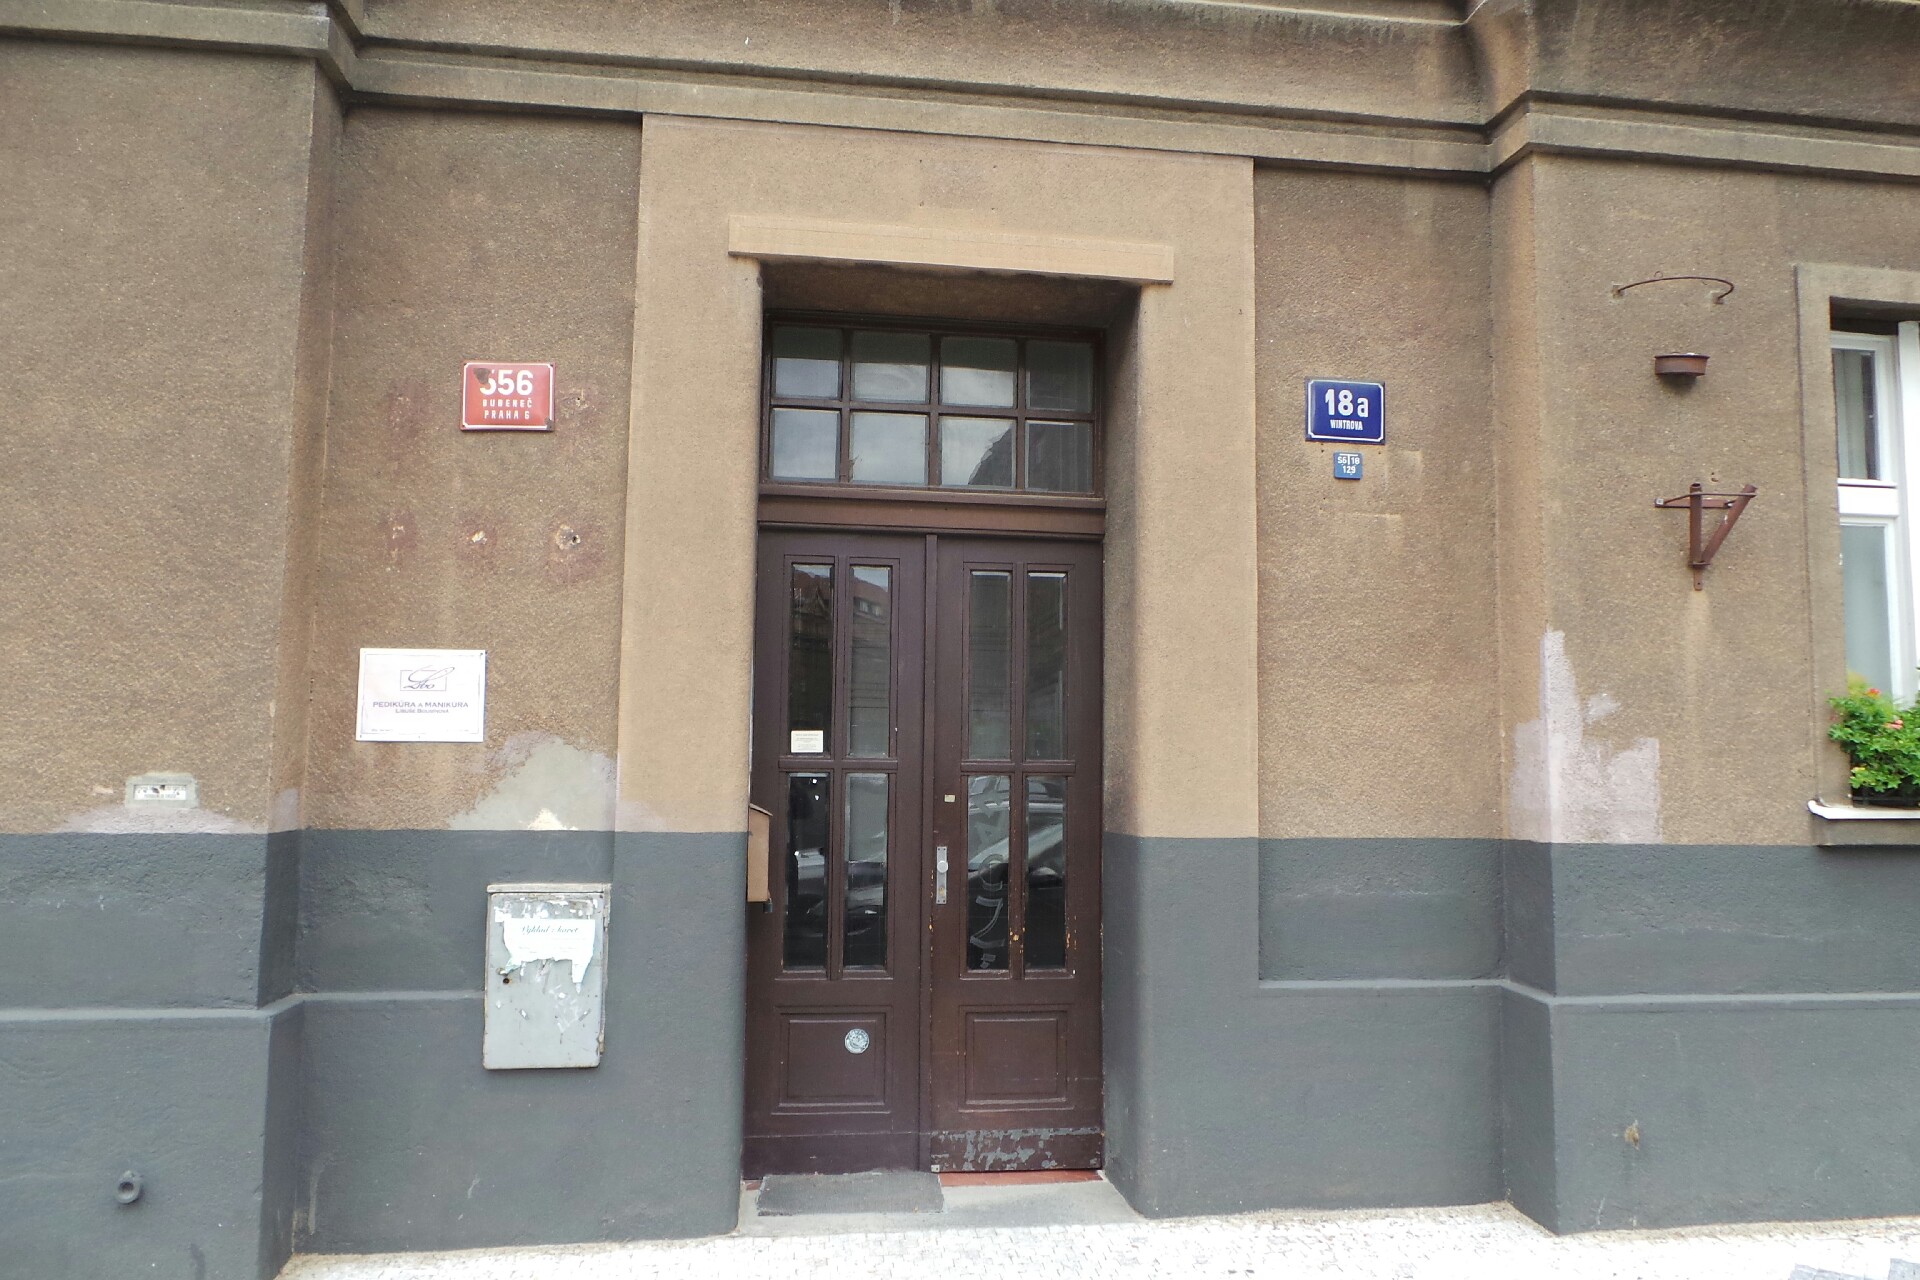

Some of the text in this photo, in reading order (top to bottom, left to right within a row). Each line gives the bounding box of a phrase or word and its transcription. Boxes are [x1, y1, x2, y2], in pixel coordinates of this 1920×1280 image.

[1325, 388, 1369, 418] 18a
[484, 410, 531, 420] PRAHA 6
[1329, 419, 1364, 431] WINTROVA
